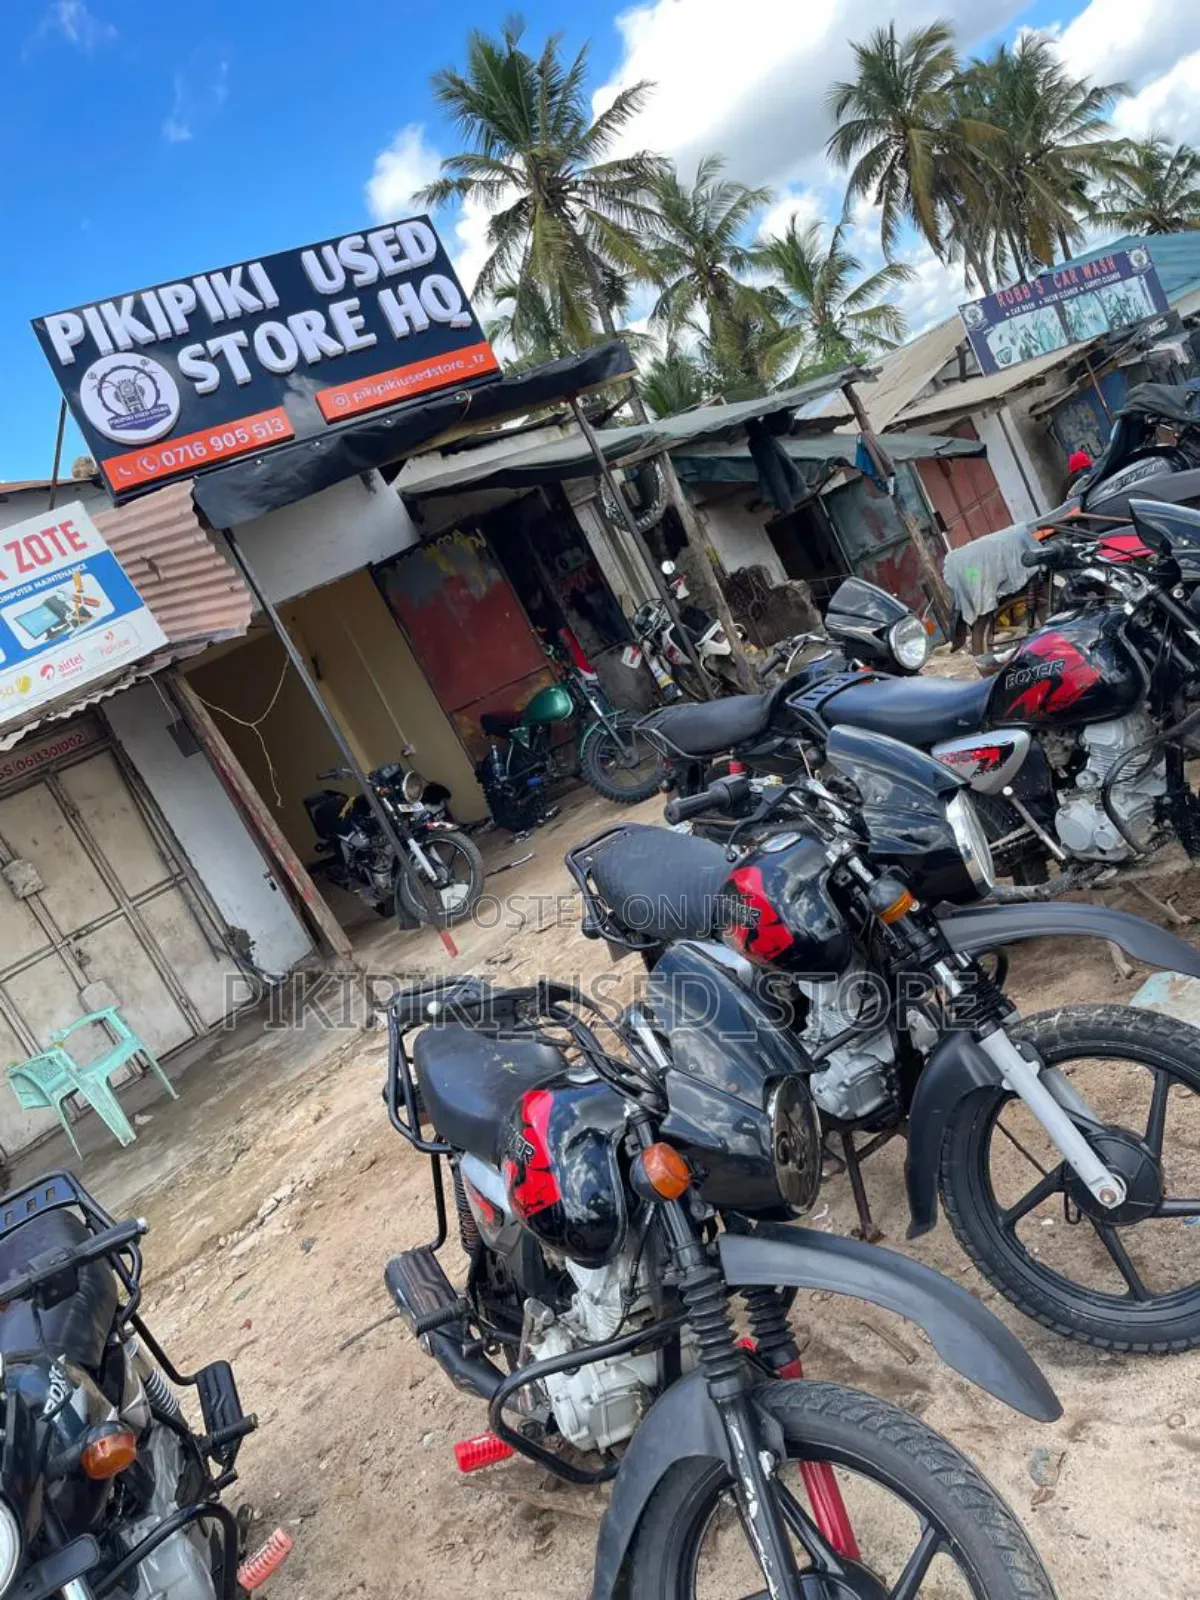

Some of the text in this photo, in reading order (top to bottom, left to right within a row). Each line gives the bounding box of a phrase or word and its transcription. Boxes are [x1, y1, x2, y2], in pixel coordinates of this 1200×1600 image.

[44, 221, 438, 365] PIKIPIKI USED
[1053, 270, 1080, 289] CAR
[1082, 256, 1116, 279] WASH
[177, 274, 474, 394] STORE HQ
[161, 417, 286, 468] 0716 905 513
[4, 519, 88, 574] ZOTE
[34, 563, 87, 591] MAINTENANCE
[57, 652, 86, 674] airtel
[1005, 659, 1066, 691] BOXER
